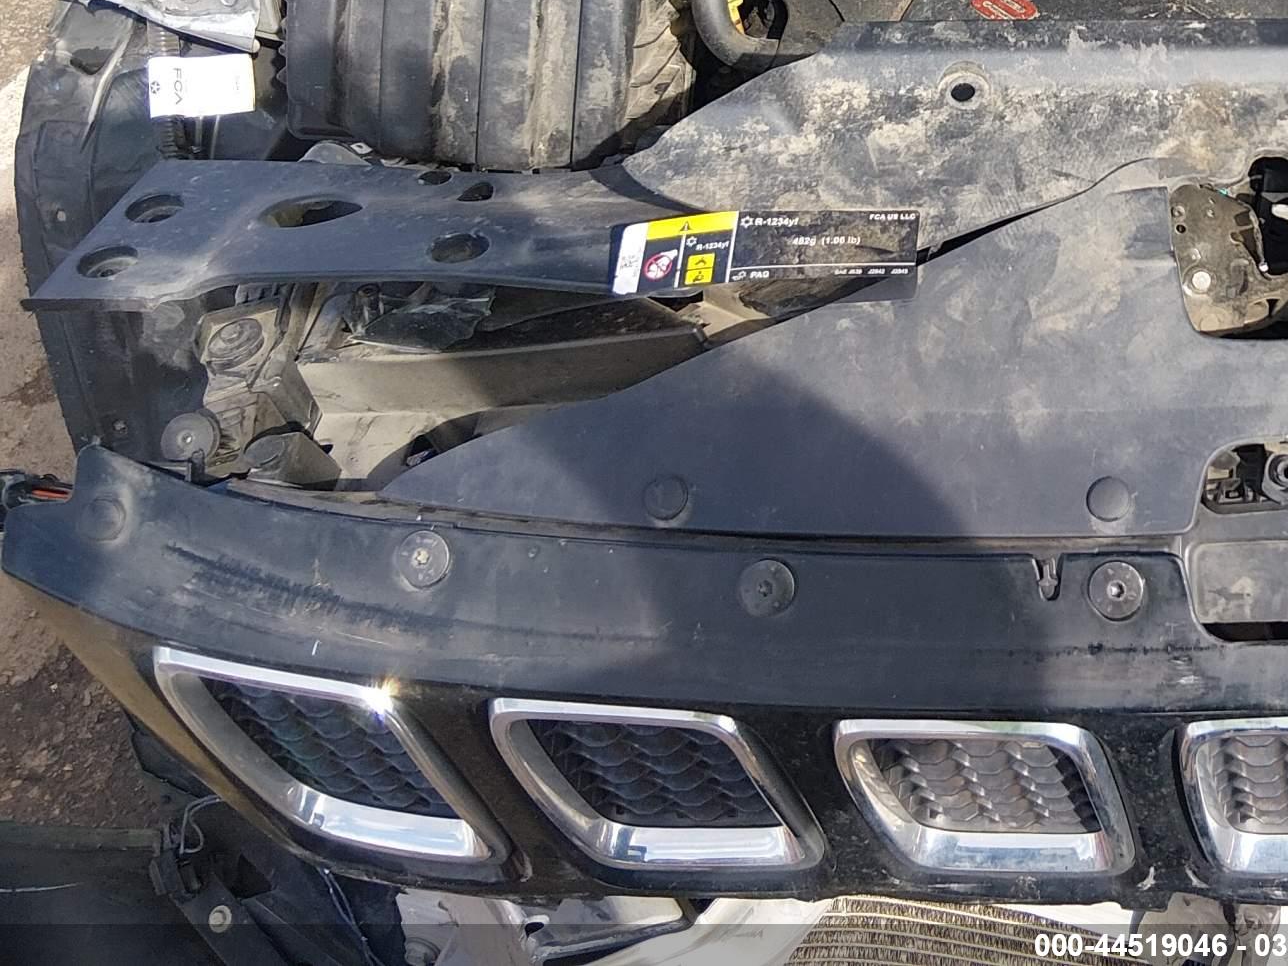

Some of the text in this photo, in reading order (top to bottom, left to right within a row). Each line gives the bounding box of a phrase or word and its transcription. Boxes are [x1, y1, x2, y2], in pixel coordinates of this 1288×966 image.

[174, 67, 183, 105] FCA
[755, 217, 799, 229] R-1234yf
[847, 236, 861, 246] lb)
